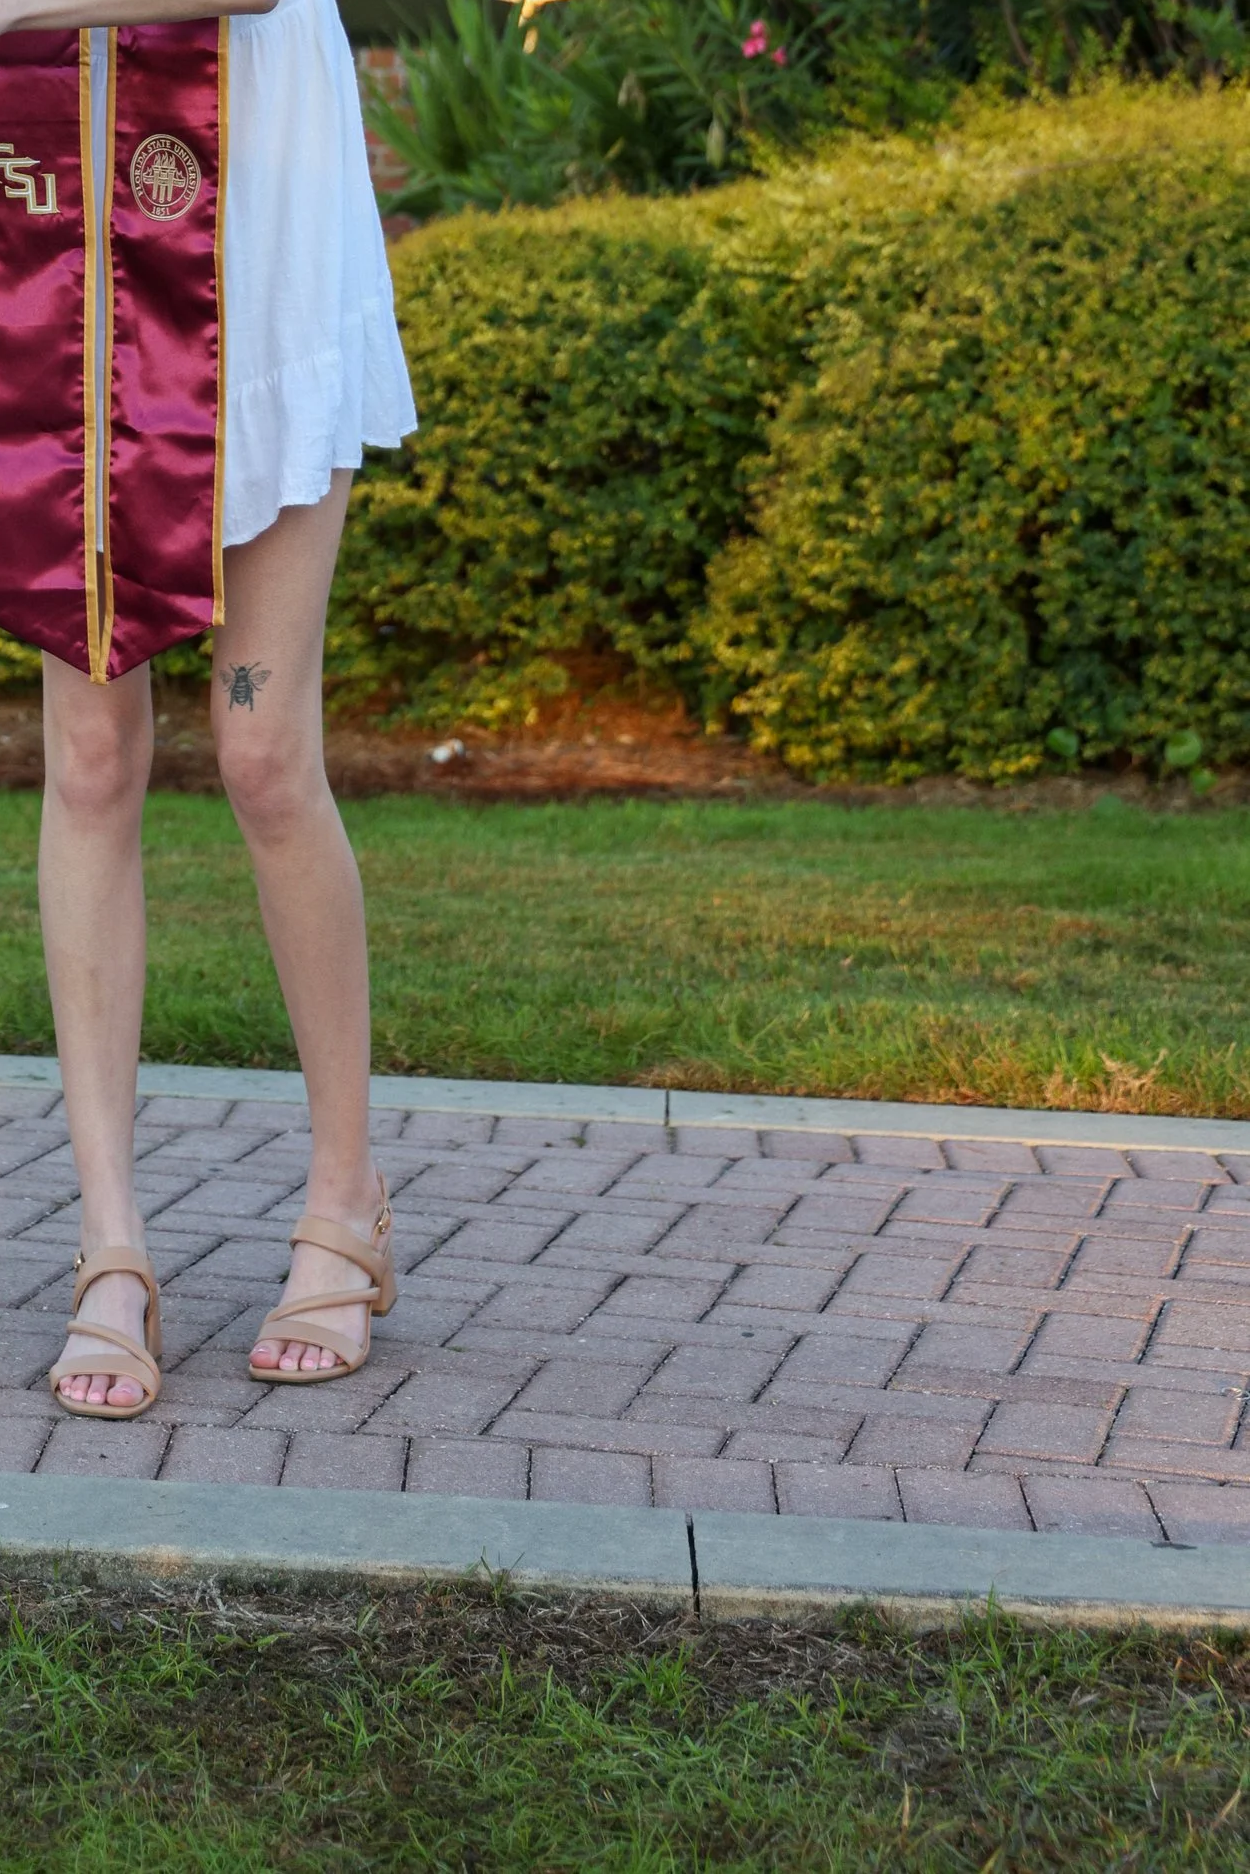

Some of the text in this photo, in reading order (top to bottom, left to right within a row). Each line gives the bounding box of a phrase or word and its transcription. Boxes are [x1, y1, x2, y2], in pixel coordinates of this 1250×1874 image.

[134, 139, 196, 202] FLORIDA STATE UNIVERSITY
[151, 206, 170, 216] 1851
